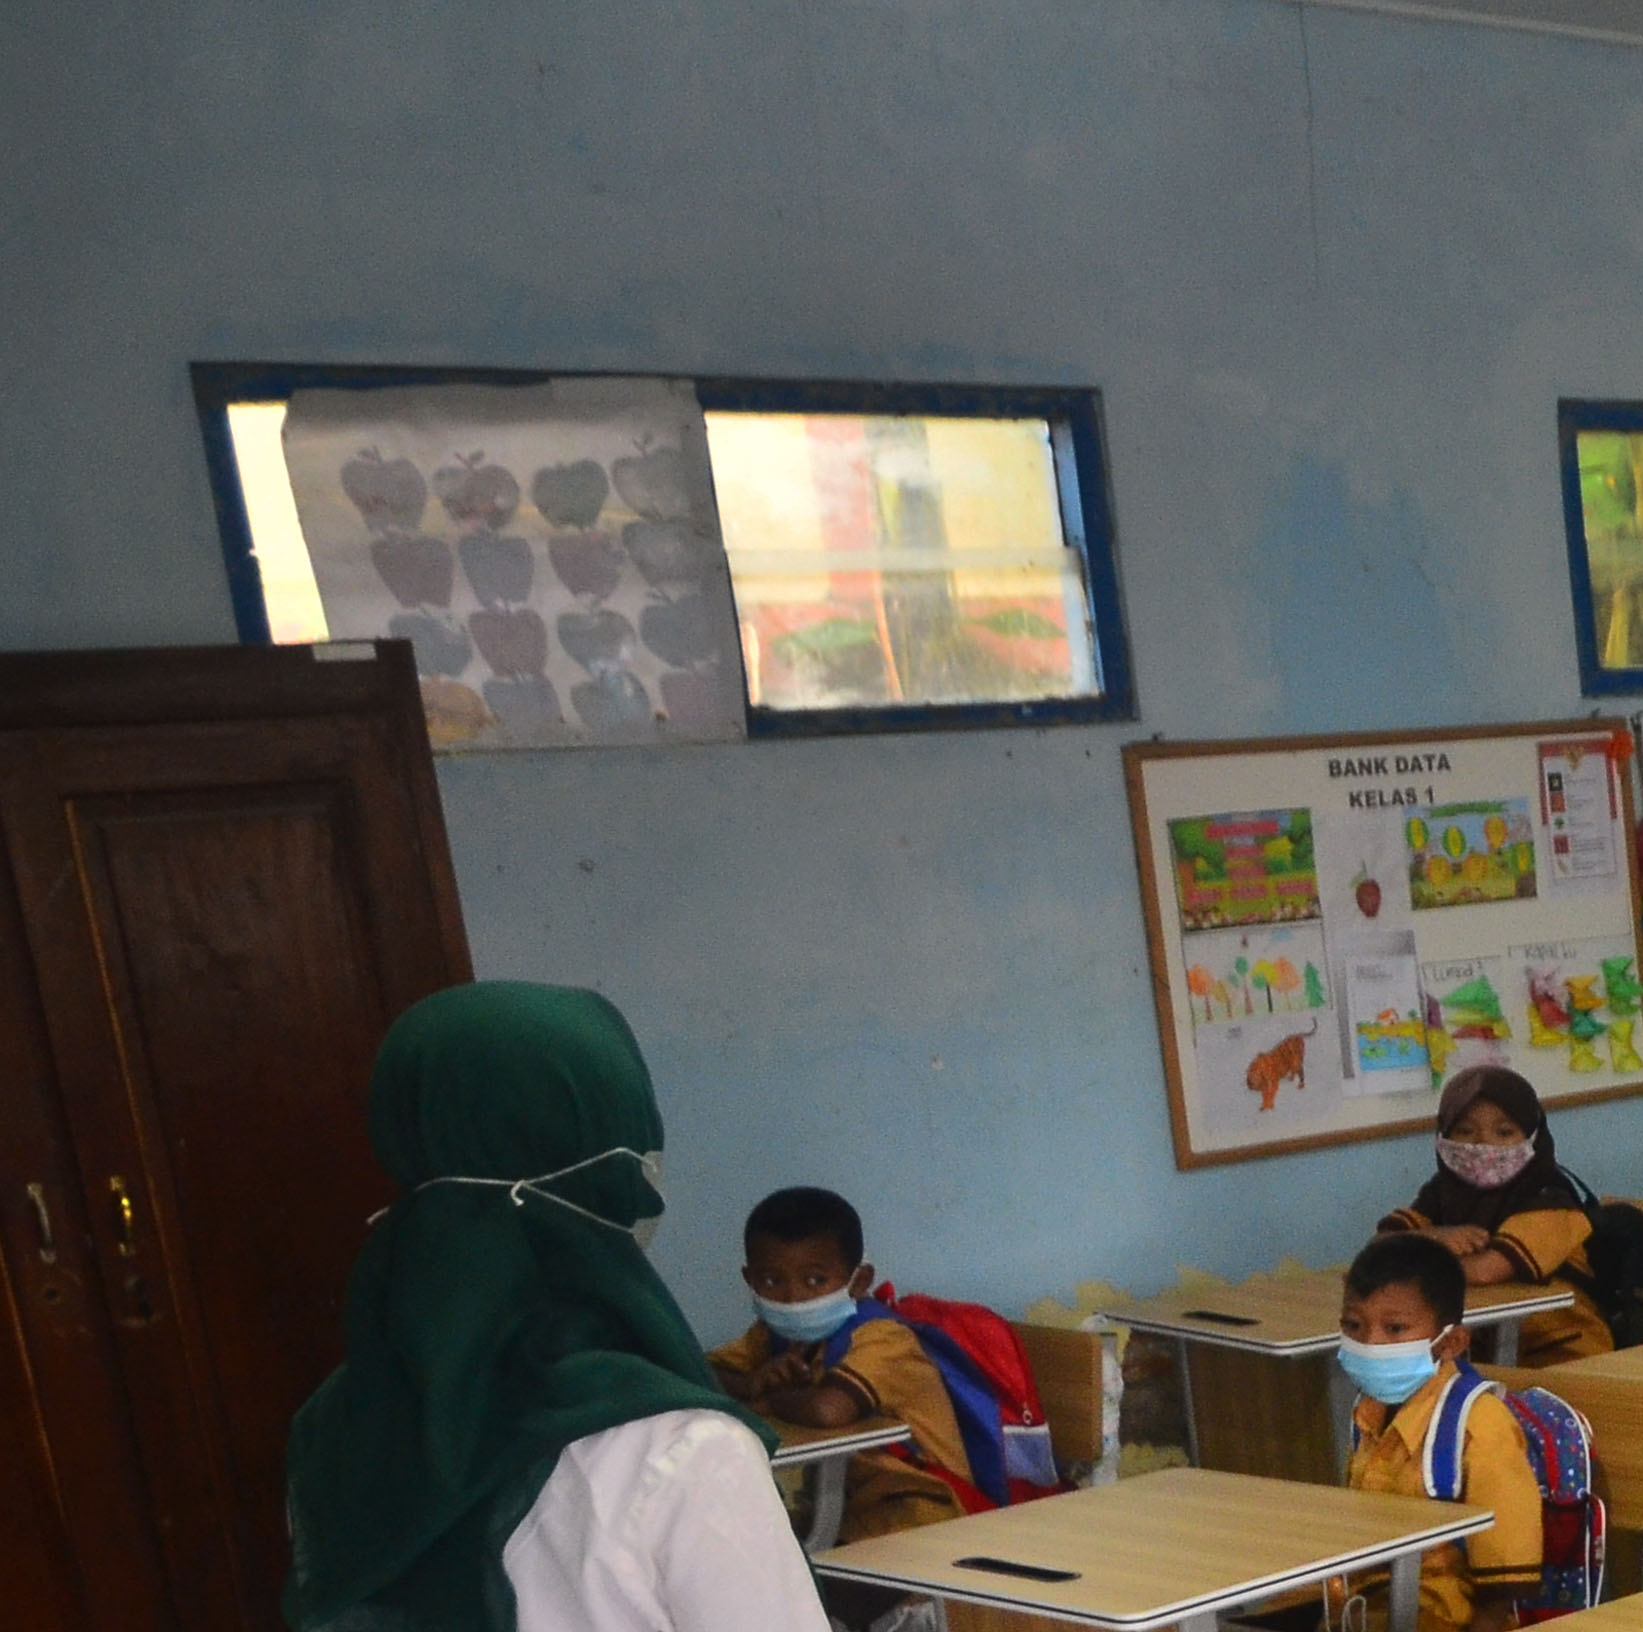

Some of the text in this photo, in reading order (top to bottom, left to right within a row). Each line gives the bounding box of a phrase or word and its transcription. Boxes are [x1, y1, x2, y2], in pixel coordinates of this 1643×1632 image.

[1328, 753, 1451, 778] BANK DATA
[1348, 785, 1435, 808] KELAS 1
